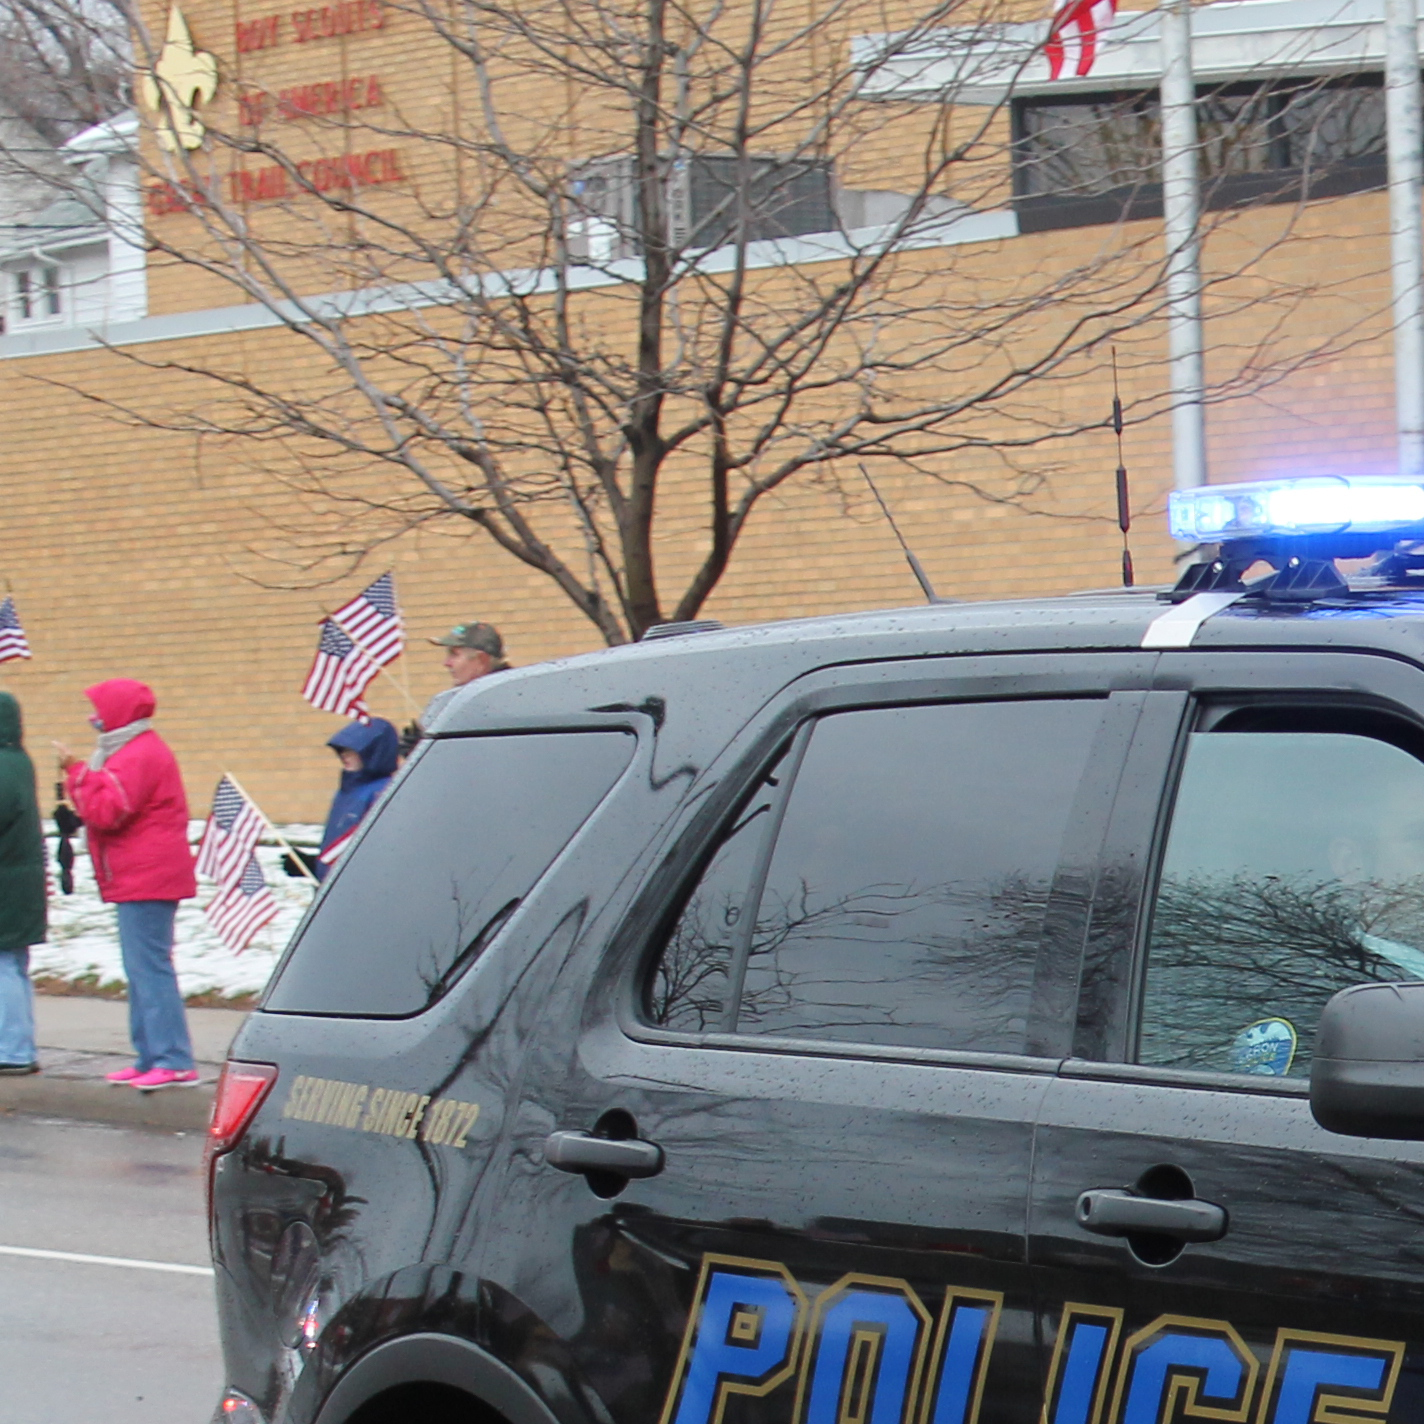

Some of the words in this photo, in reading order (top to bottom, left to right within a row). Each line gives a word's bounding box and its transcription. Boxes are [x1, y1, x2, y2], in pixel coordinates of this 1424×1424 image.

[283, 1075, 369, 1130] SERVING
[362, 1087, 431, 1140] SINCE
[423, 1099, 480, 1149] 1872
